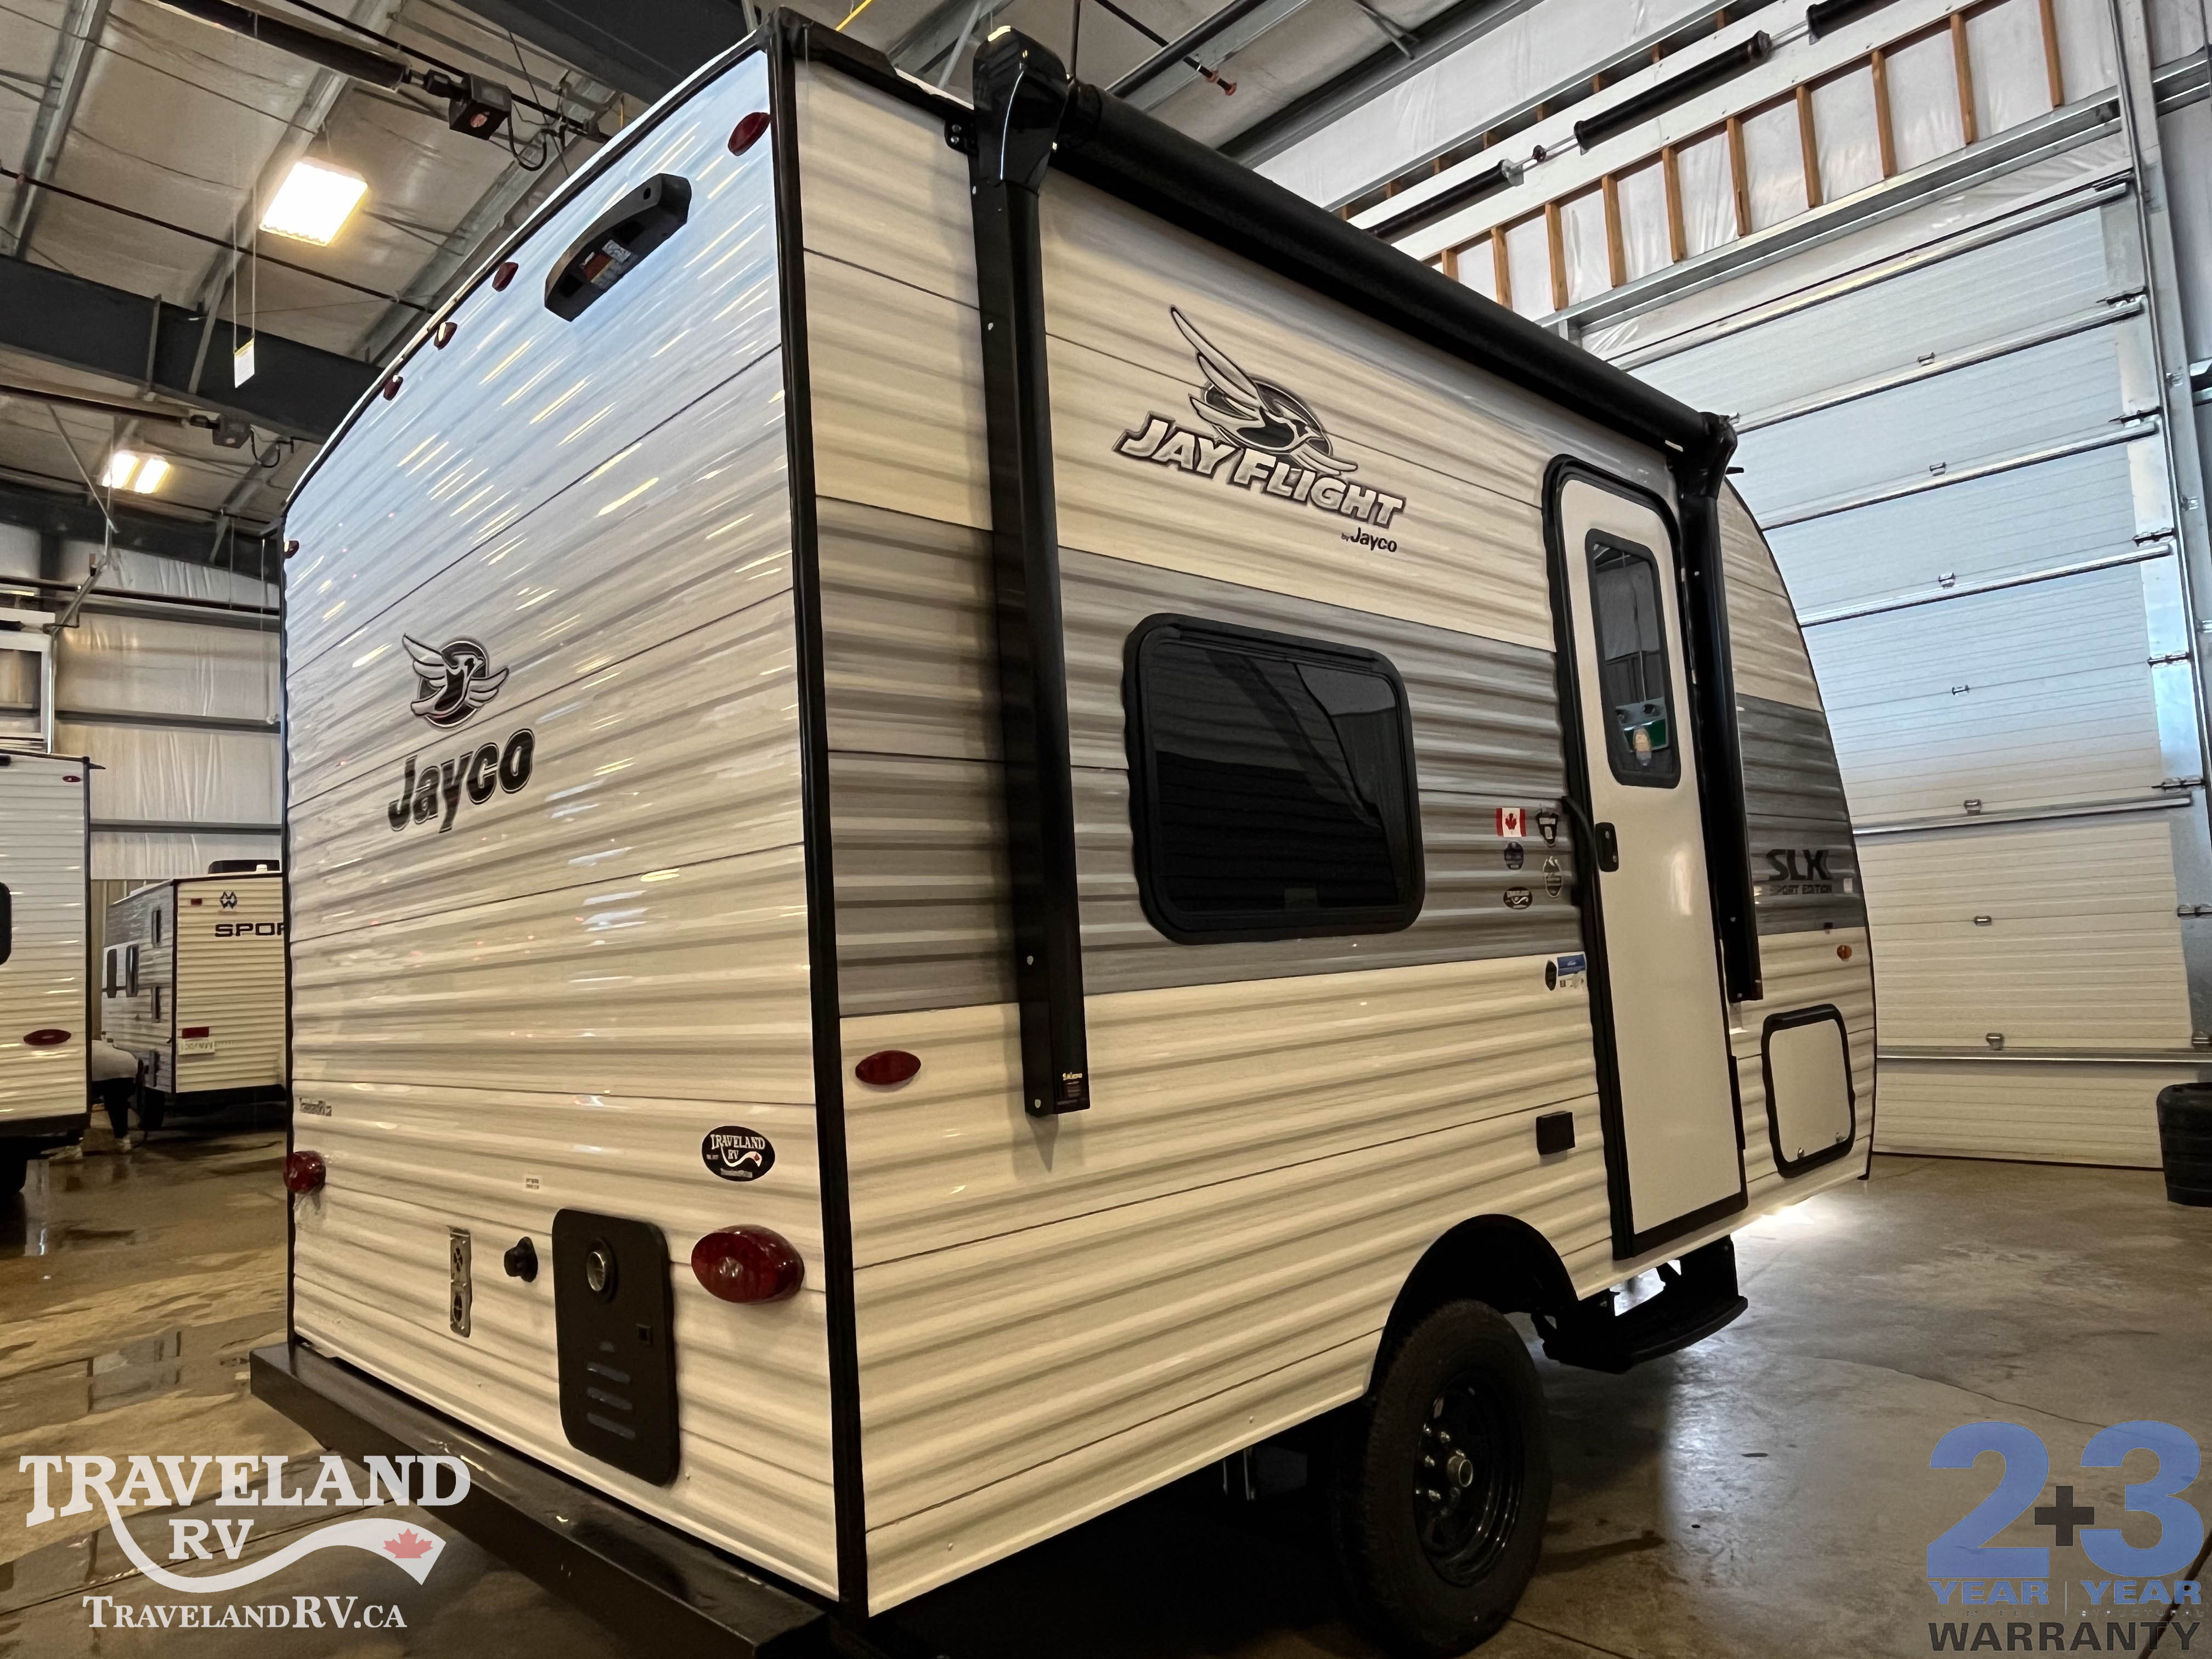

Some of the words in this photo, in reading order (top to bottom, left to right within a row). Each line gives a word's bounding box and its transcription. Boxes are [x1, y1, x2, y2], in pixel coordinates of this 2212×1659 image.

[1113, 412, 1241, 479] JAY
[1227, 447, 1406, 529] FLIGHT
[1350, 527, 1397, 552] Jayco
[387, 728, 535, 833] Jayco
[1766, 849, 1833, 881] SLK
[710, 1134, 766, 1150] TRAVELAND
